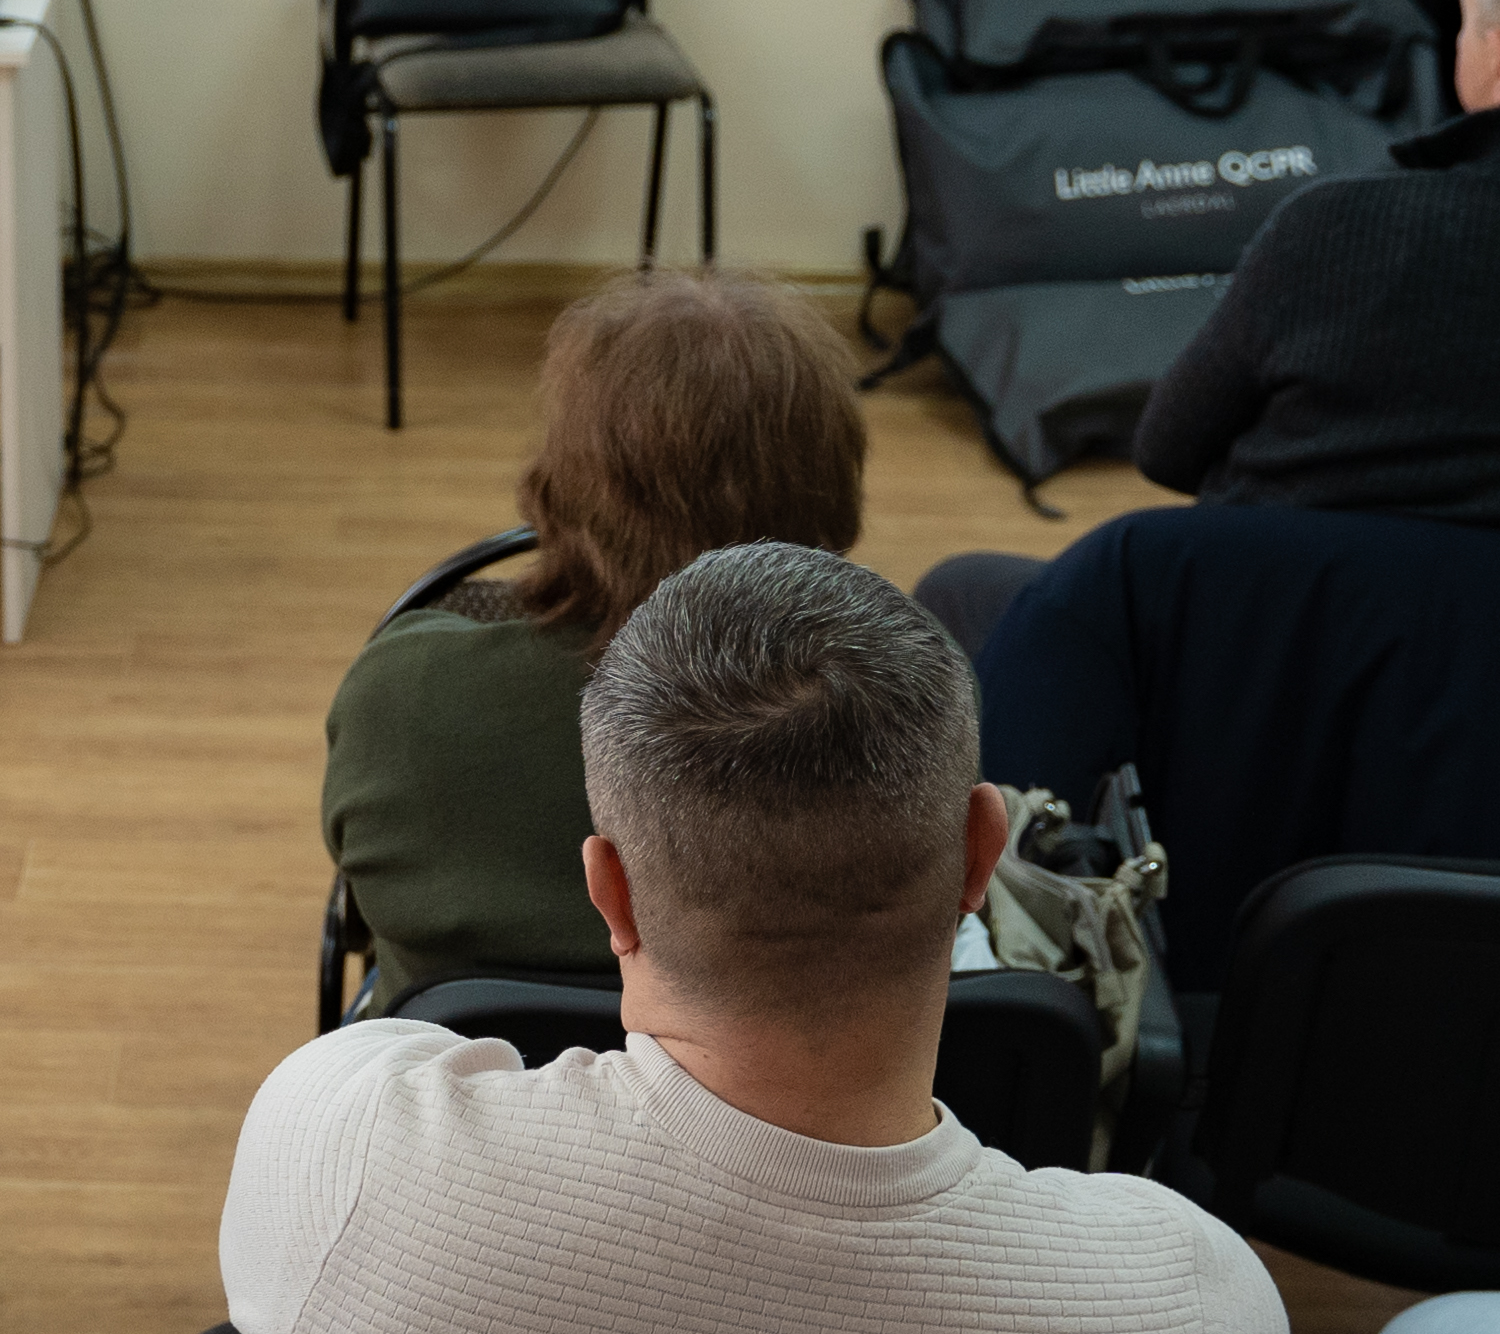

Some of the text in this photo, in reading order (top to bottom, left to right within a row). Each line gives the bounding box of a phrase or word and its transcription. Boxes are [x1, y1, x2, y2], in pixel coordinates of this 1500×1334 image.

[1054, 145, 1317, 201] Little Anne QCPR
